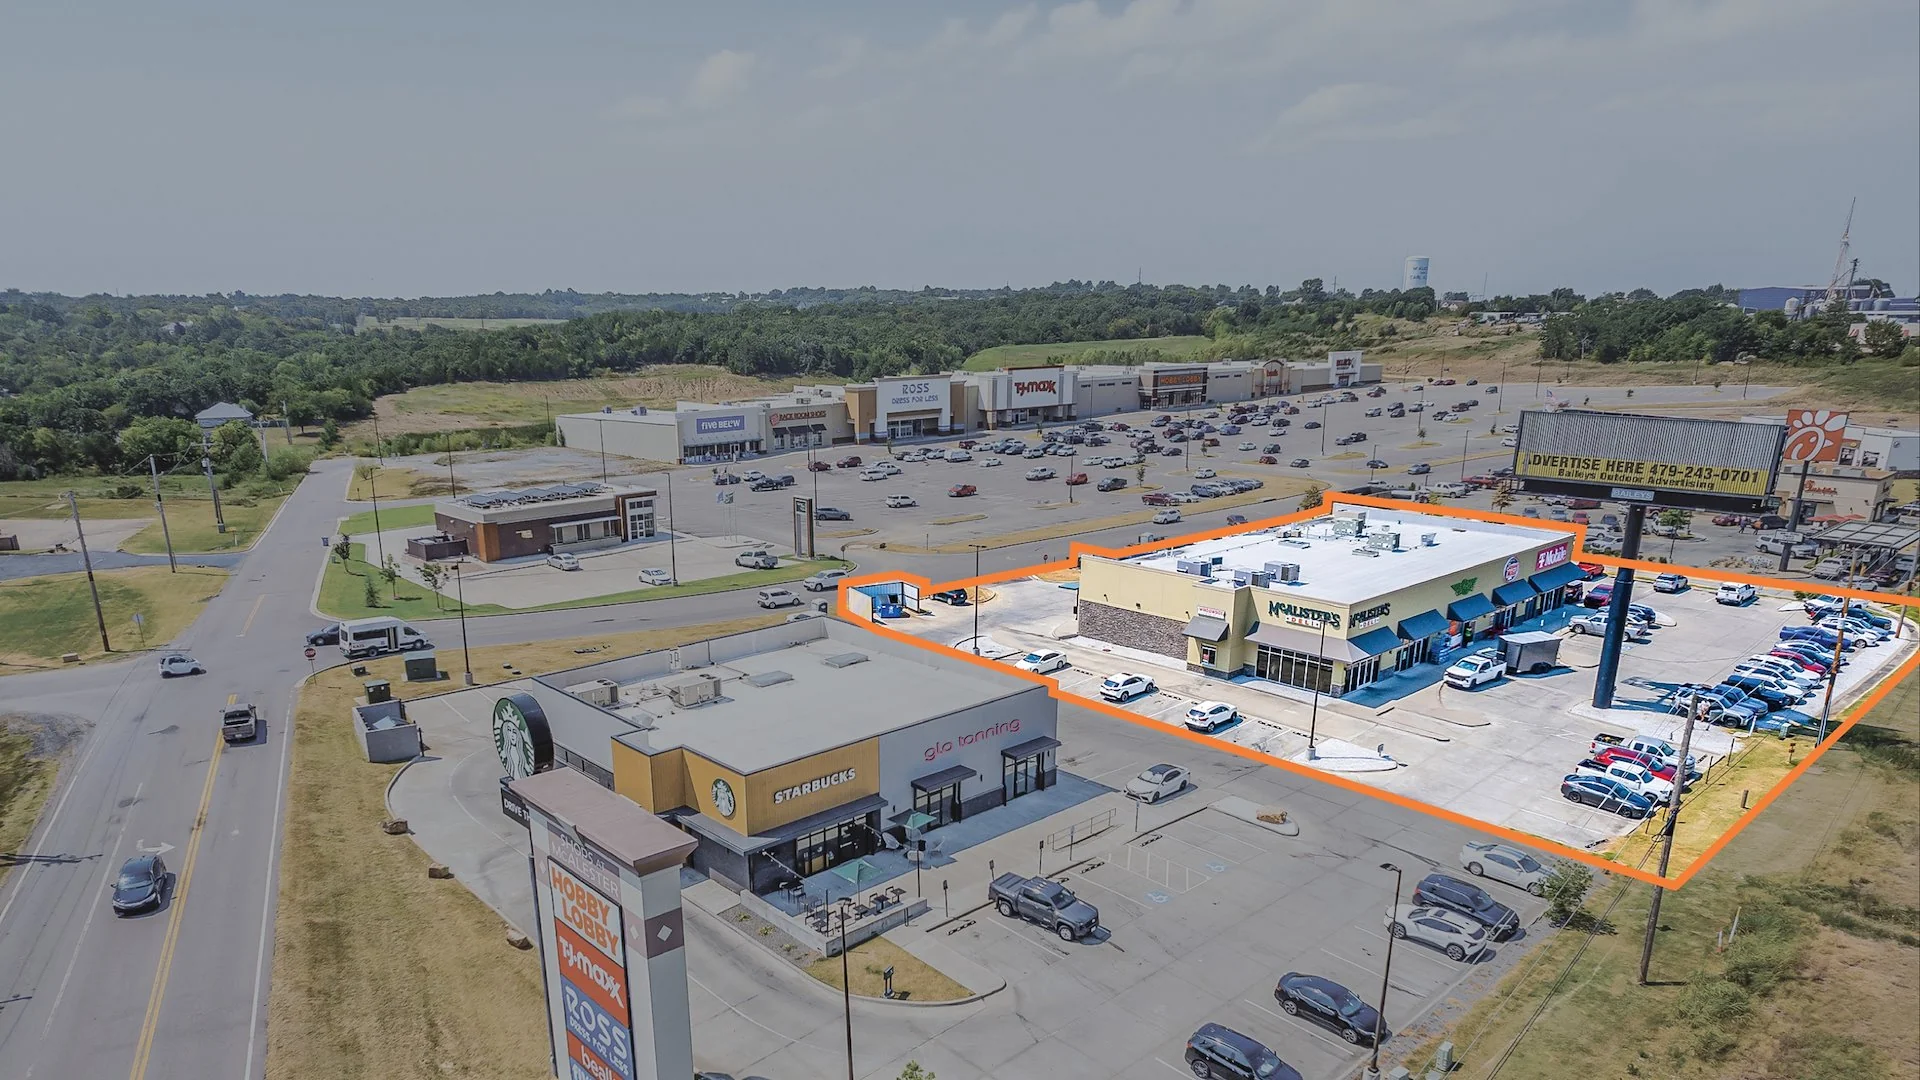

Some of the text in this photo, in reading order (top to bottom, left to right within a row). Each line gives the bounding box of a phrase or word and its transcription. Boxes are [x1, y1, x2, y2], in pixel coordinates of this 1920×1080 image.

[891, 396, 910, 404] DRESS
[924, 394, 939, 402] LESS
[902, 383, 930, 394] ROSS
[702, 421, 717, 430] five
[1558, 468, 1715, 490] Baileys Outdoor Advertising
[1606, 460, 1645, 474] HERE
[1649, 463, 1759, 483] 479-243-0701
[1614, 490, 1652, 499] BAILEYS
[1291, 617, 1314, 626] DELI
[924, 740, 953, 762] glo
[774, 768, 856, 804] STARBUCKS
[504, 798, 531, 821] DRIVE TH
[560, 833, 594, 865] SHOPS
[551, 866, 610, 926] HOBBY
[562, 897, 619, 957] LOBBY
[565, 985, 628, 1060] ROSS
[569, 1015, 591, 1043] DRESS
[592, 1037, 608, 1058] FOR
[609, 1052, 629, 1076] LESS
[581, 1045, 616, 1080] beall
